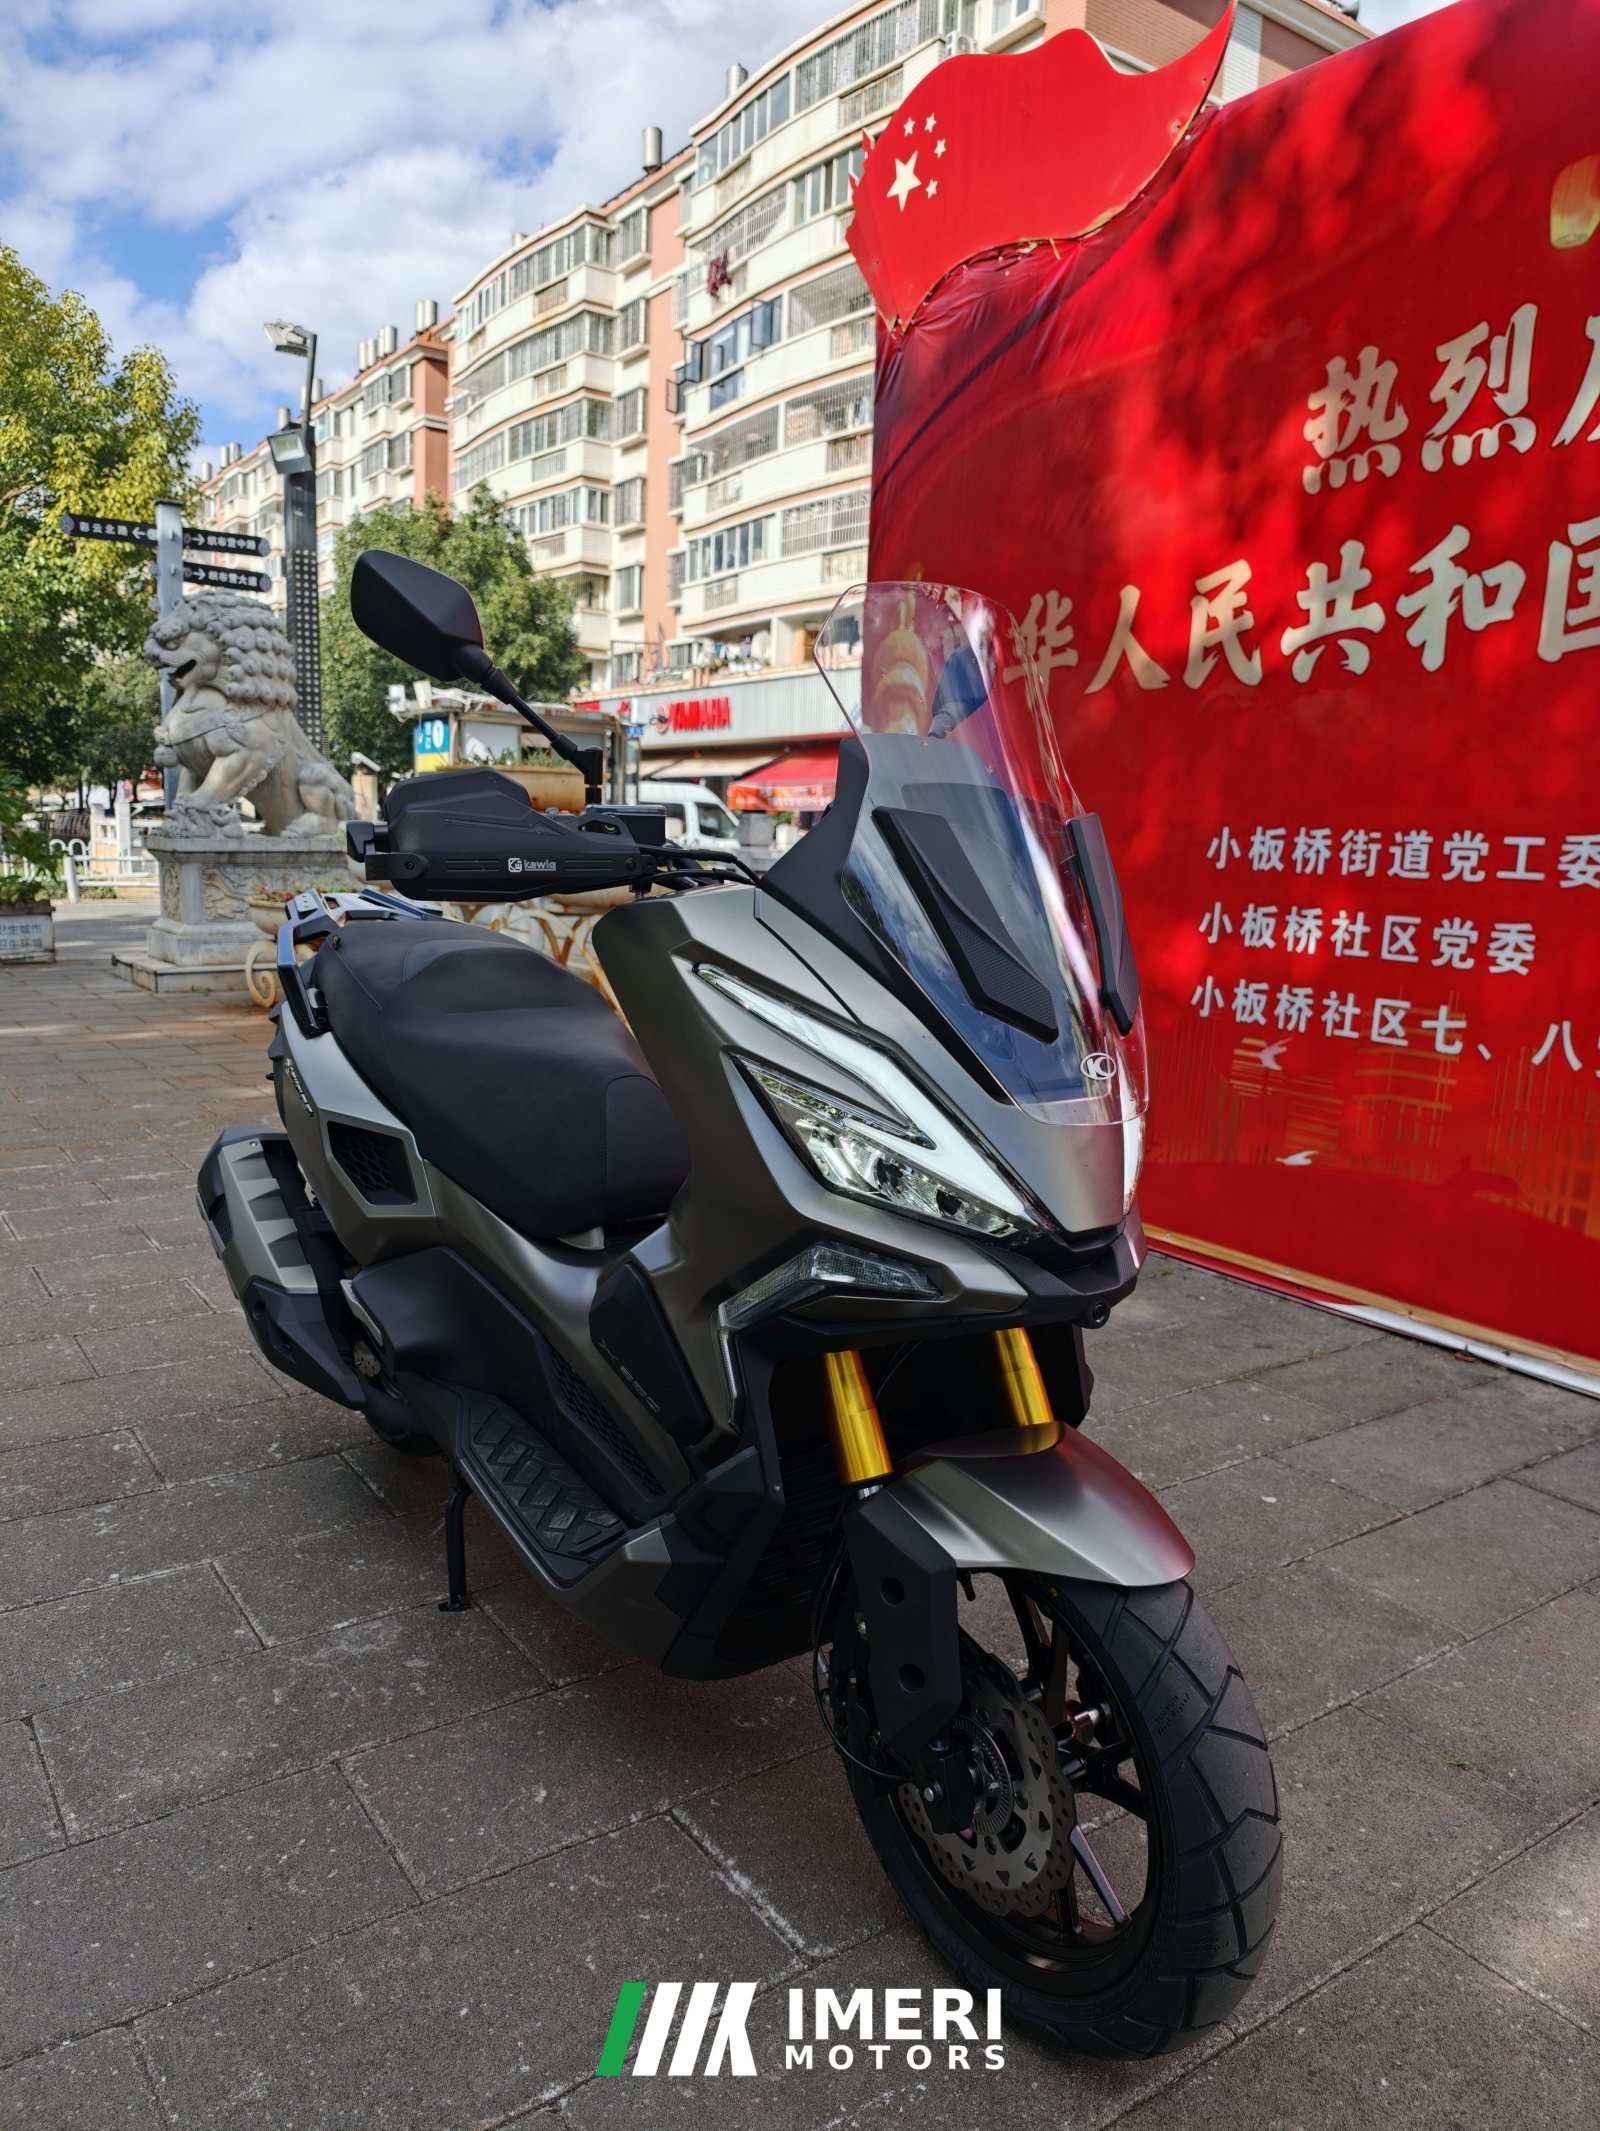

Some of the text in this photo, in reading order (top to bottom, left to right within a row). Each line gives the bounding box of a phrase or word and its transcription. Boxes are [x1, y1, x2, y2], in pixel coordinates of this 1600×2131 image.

[79, 521, 128, 536] 彩云北路
[668, 697, 731, 732] YAMAHA
[1206, 826, 1600, 889] 小板桥街道党工委
[1198, 902, 1537, 976] 小板桥社区党委
[1190, 975, 1600, 1079] 小板桥社区七、八
